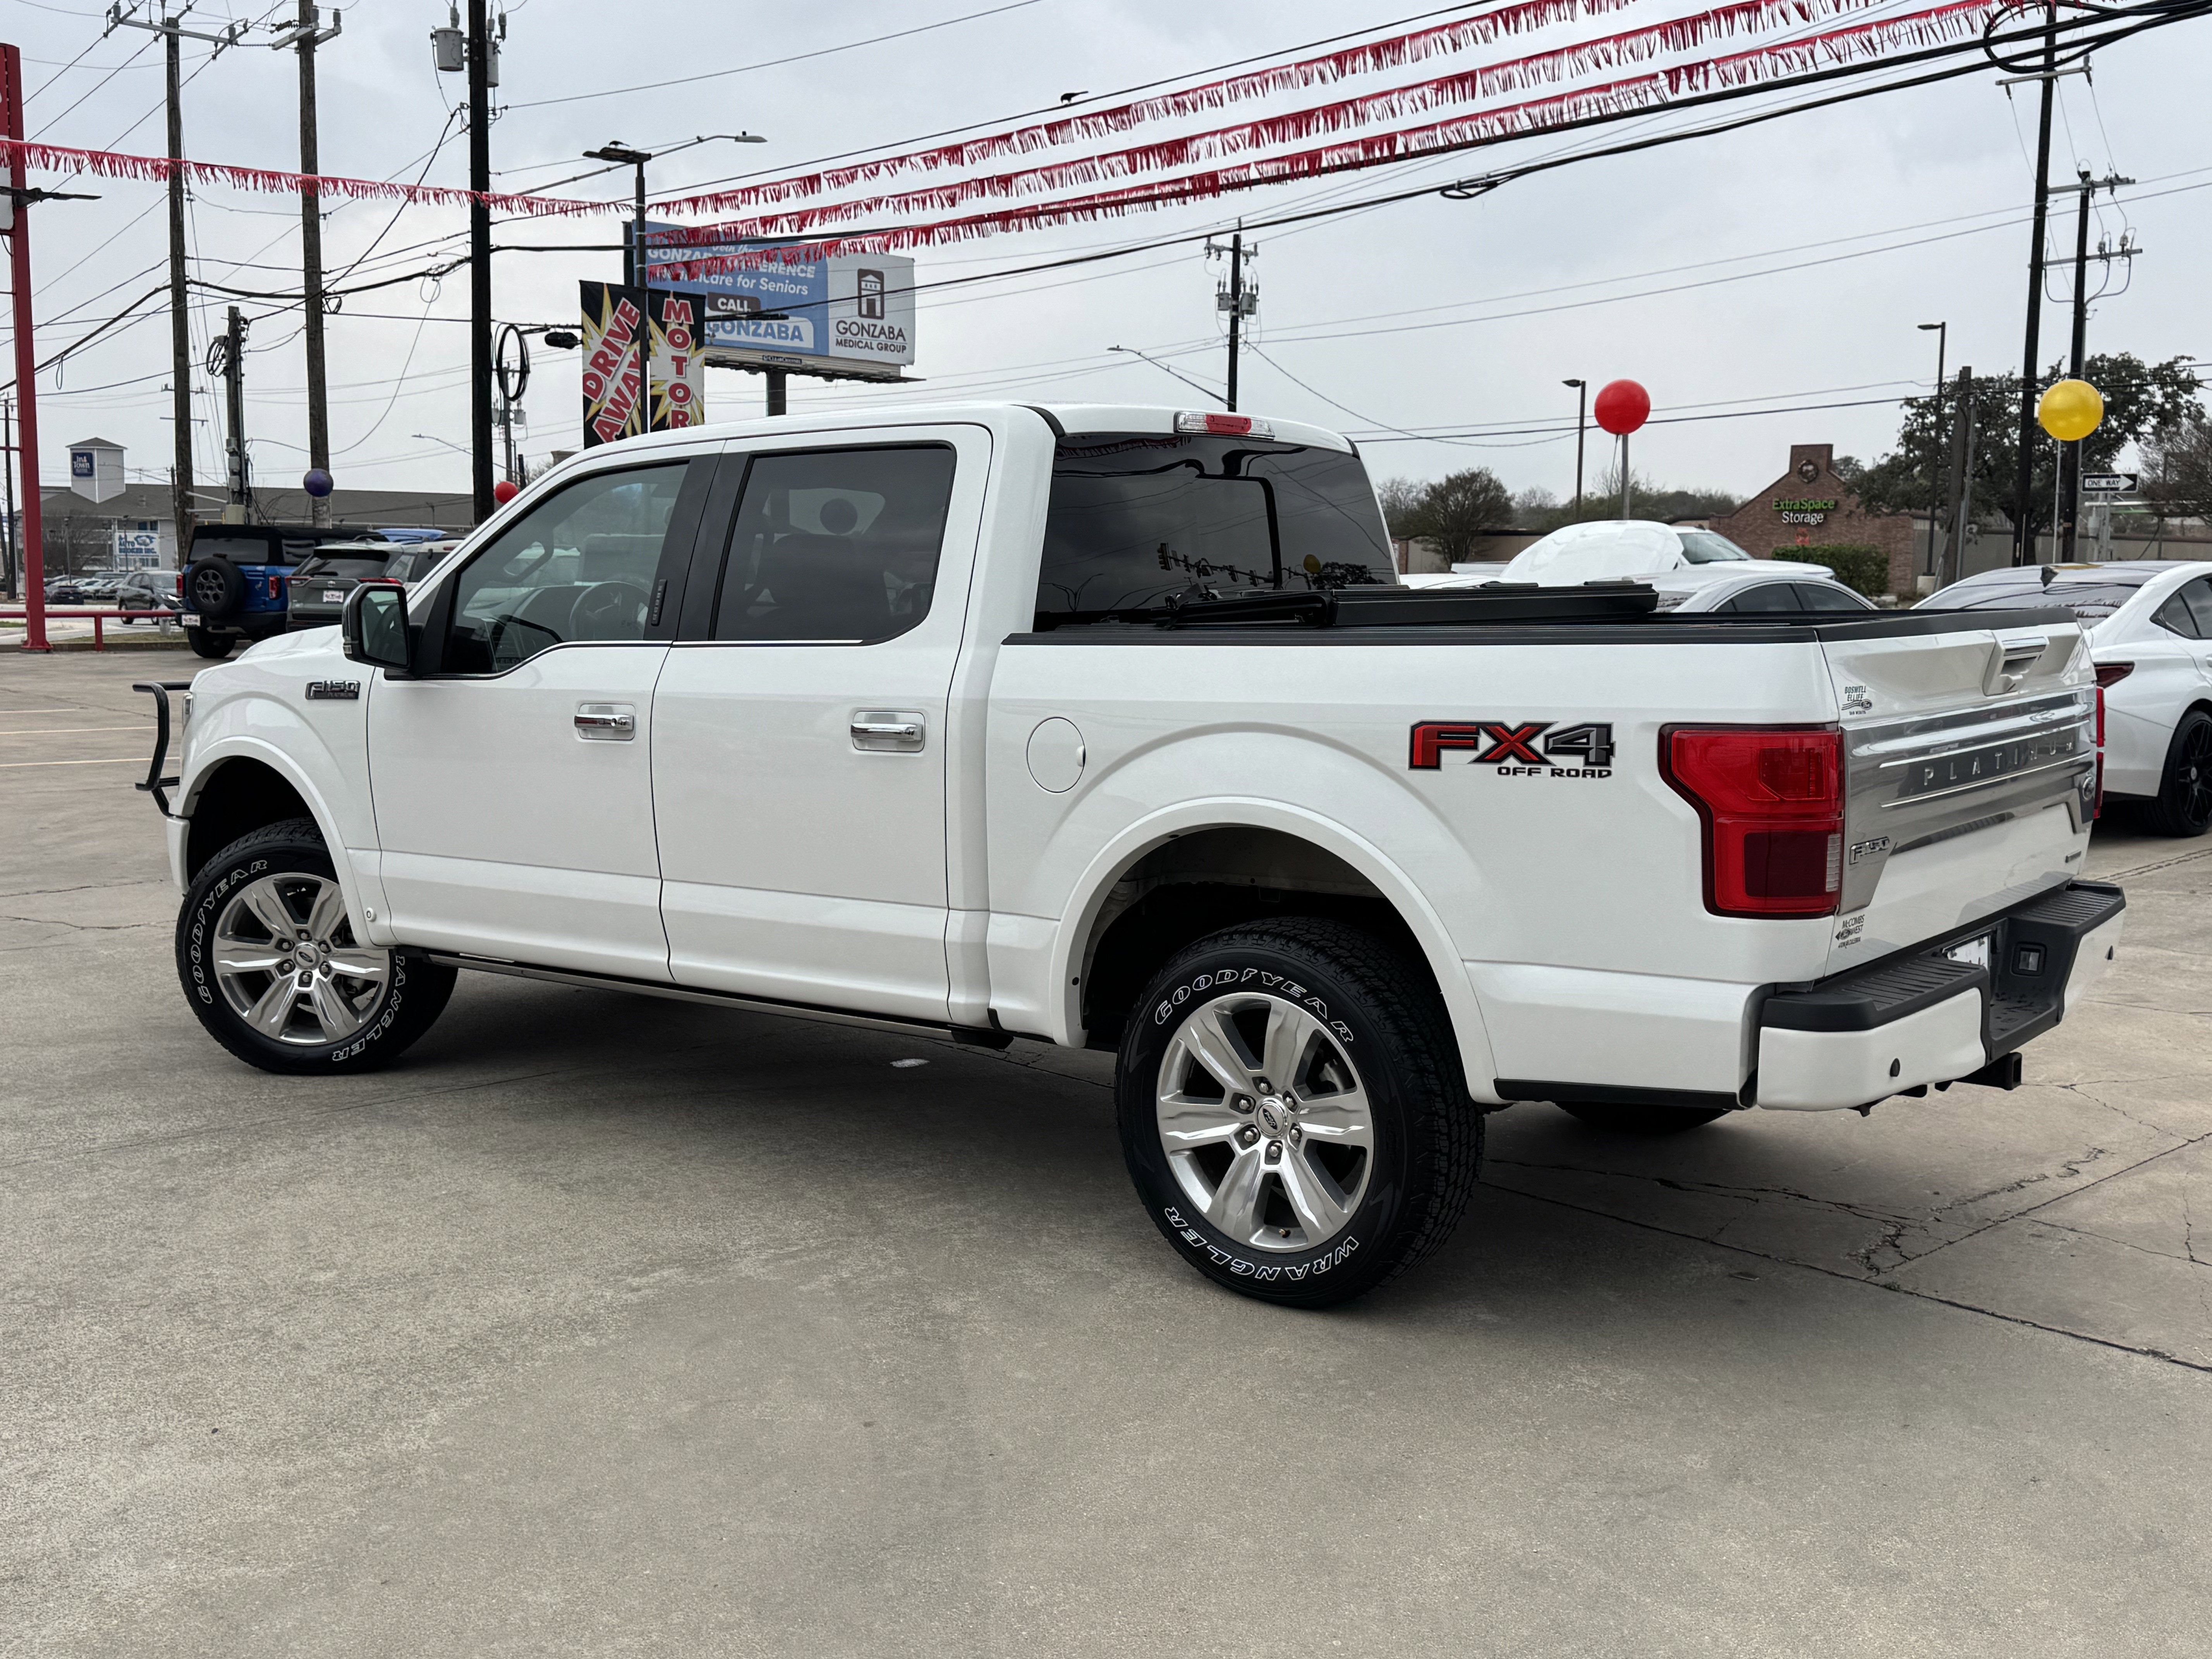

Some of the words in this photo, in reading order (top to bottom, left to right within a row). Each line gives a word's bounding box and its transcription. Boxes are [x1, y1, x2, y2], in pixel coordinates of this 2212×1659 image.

[737, 274, 756, 289] for
[759, 278, 809, 295] Seniors
[717, 297, 751, 312] CALL
[707, 320, 804, 342] GONZABA
[835, 320, 907, 342] GONZABA
[582, 297, 640, 403] DRIVE
[835, 338, 874, 350] MEDICAL
[876, 343, 907, 354] GROUP
[1782, 511, 1824, 526] Storage
[1408, 719, 1616, 771] FX4
[1497, 766, 1542, 777] OFF
[1550, 768, 1613, 779] ROAD
[1923, 741, 2074, 786] PLATINUM
[190, 859, 268, 1004] GOODYEAR
[1154, 967, 1354, 1043] GOODYEAR
[1164, 1206, 1360, 1281] WRANGLER
